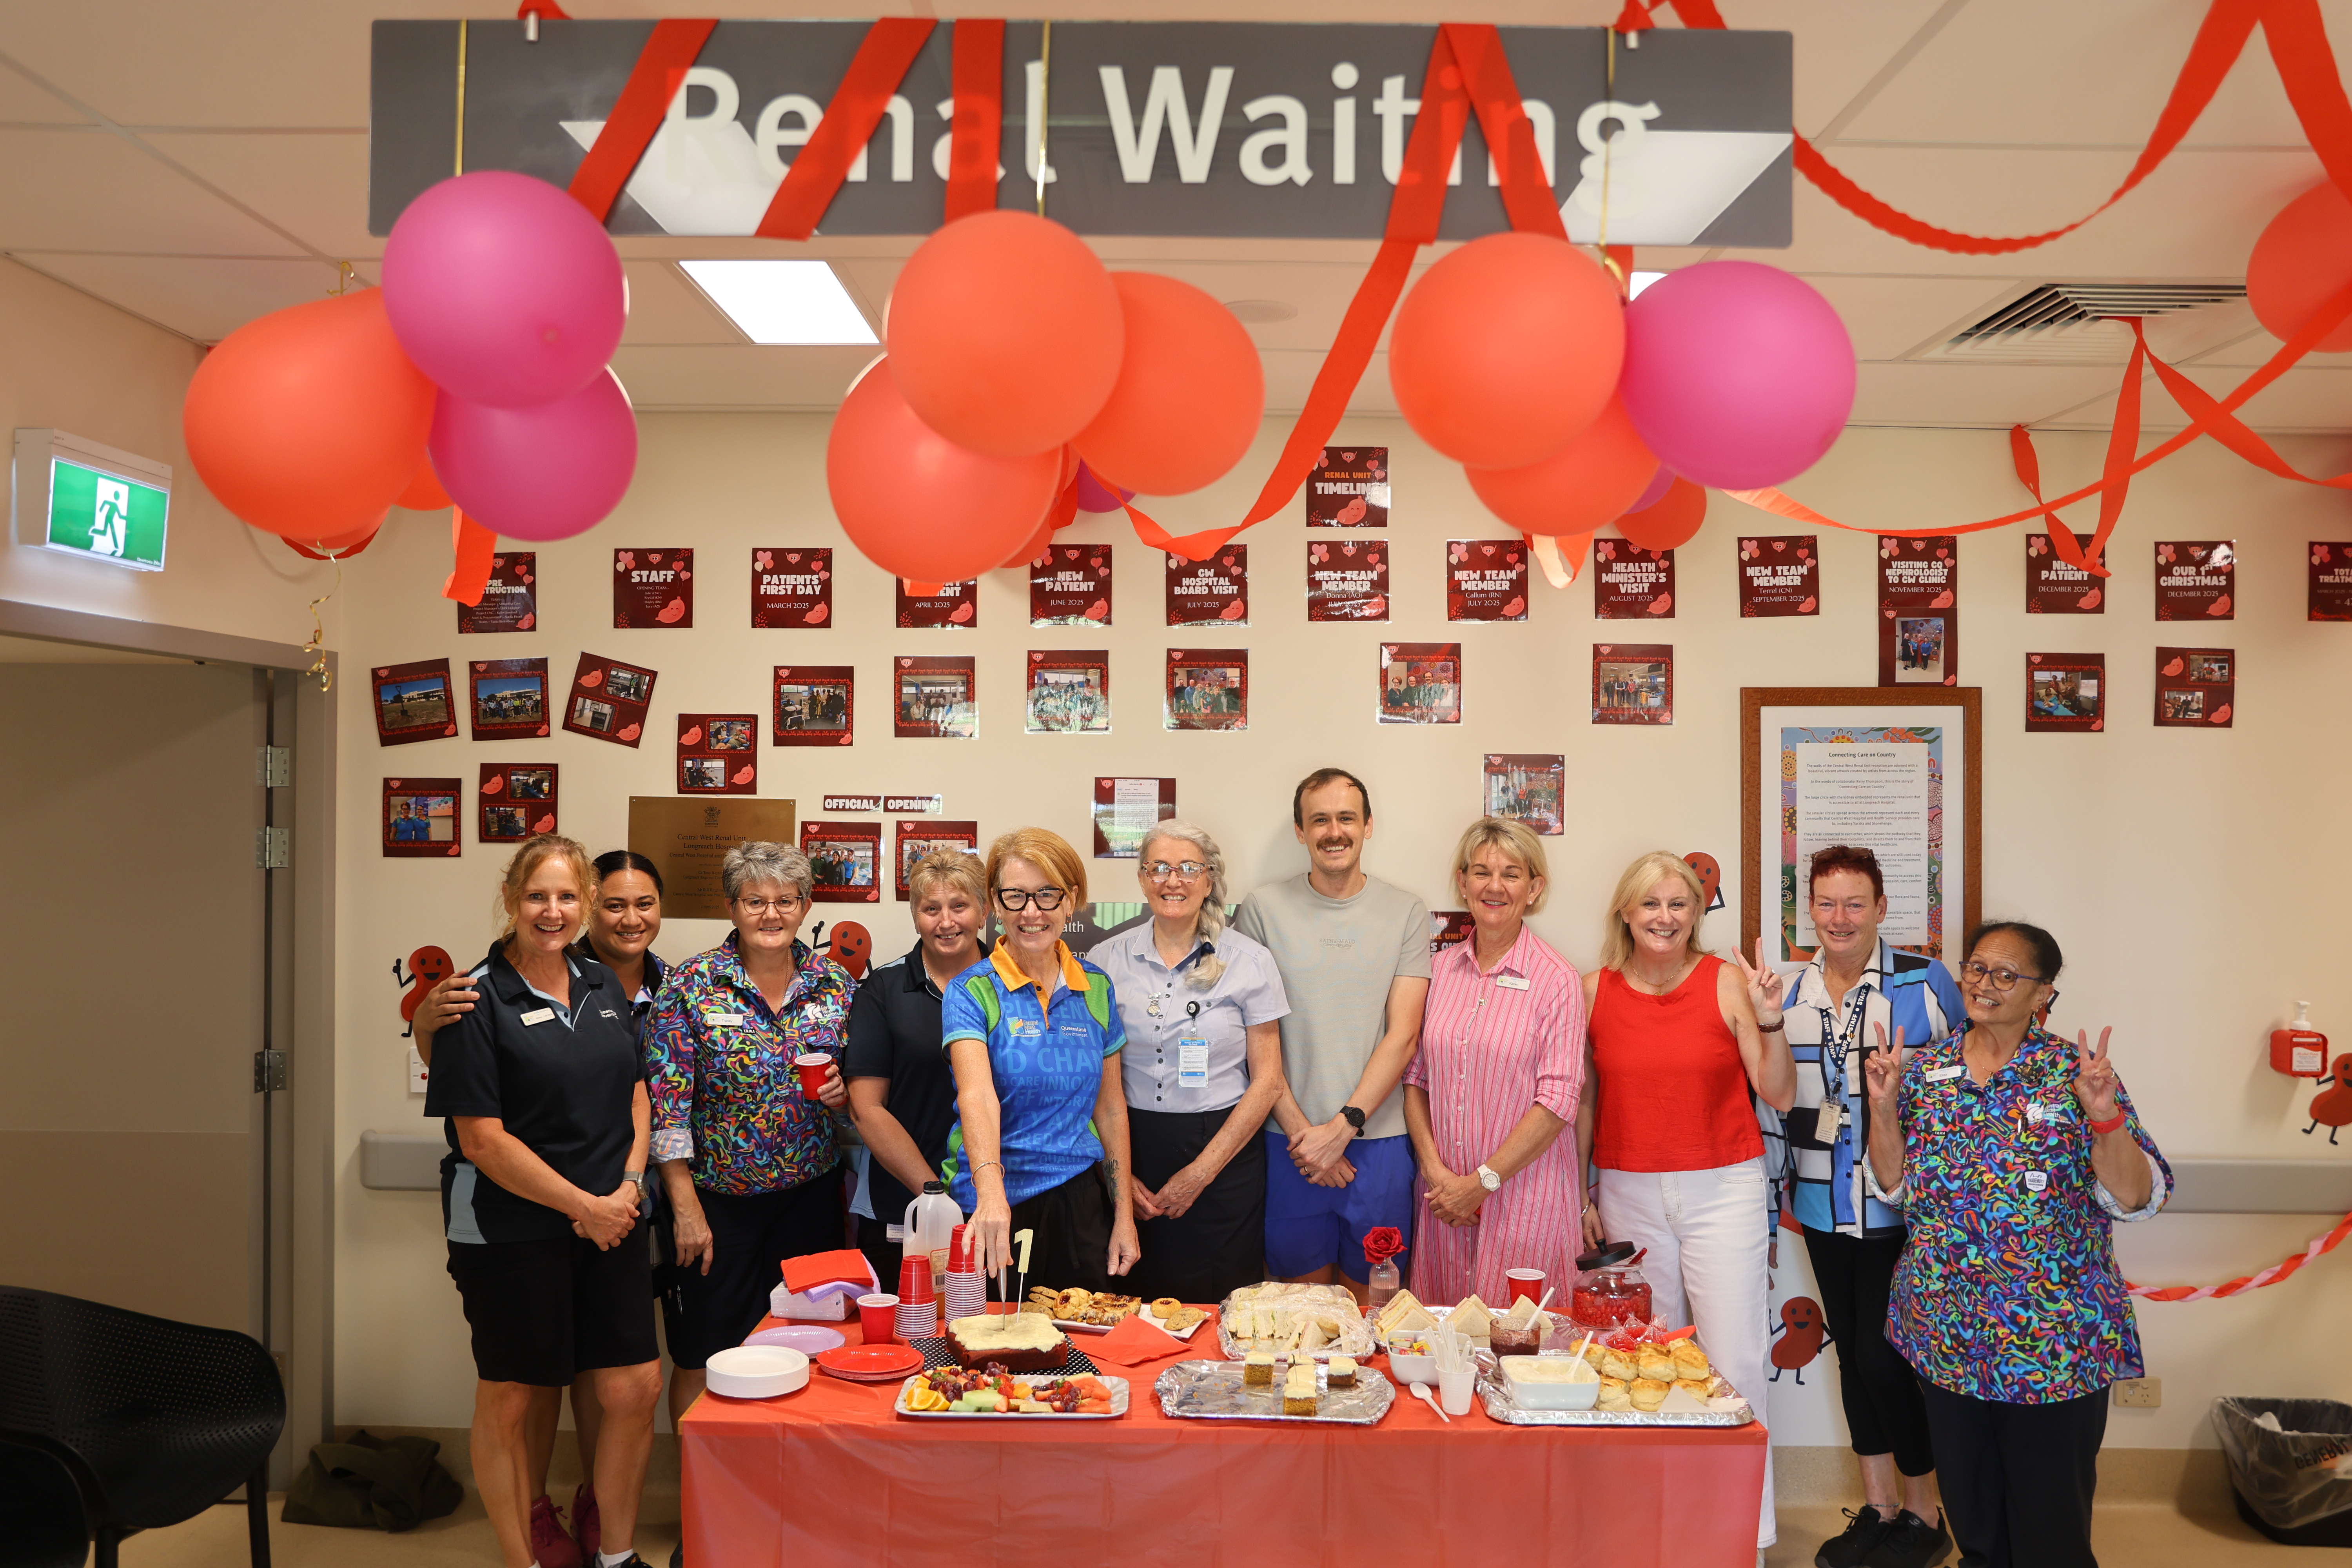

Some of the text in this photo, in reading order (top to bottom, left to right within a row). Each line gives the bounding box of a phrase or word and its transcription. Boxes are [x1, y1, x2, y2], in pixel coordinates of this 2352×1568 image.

[666, 60, 1662, 218] Renal Waiting
[1612, 562, 1655, 573] HEALTH
[1931, 561, 1943, 569] CQ
[631, 570, 675, 583] STAFF
[1056, 571, 1083, 581] NEW
[1198, 568, 1214, 577] CW
[1315, 571, 1377, 581] NEW TEAM
[1454, 570, 1517, 580] NEW TEAM
[1746, 565, 1808, 577] NEW TEAM
[1886, 568, 1948, 576] NEPHROLOGIST
[2041, 569, 2089, 581] PATIENT
[2172, 566, 2196, 576] OUR
[763, 574, 820, 585] PATIENTS
[1182, 577, 1230, 586] HOSPITAL
[1602, 572, 1666, 583] MINISTER'S
[1751, 575, 1801, 586] MEMBER
[1902, 575, 1918, 584] CW
[1918, 575, 1947, 584] CLINIC
[2160, 575, 2227, 586] CHRISTMAS
[760, 584, 822, 595] FIRST DAY
[1045, 581, 1095, 591] PATIENT
[1174, 586, 1238, 595] BOARD VISIT
[1322, 581, 1371, 591] MEMBER
[1461, 580, 1510, 590] MEMBER
[1619, 583, 1650, 593] VISIT
[824, 799, 875, 809] OFFICIAL
[887, 799, 940, 810] OPENING
[1062, 921, 1084, 932] alth
[1857, 988, 1867, 1005] STAFF
[1823, 1017, 1831, 1033] STAFF
[1849, 1014, 1858, 1031] STAFF
[1828, 1041, 1837, 1059] STAFF
[1839, 1039, 1849, 1058] STAFF
[1037, 1047, 1103, 1073] CHAN
[1010, 1076, 1040, 1087] CARE
[2018, 1074, 2029, 1083] ELIZA
[1042, 1076, 1101, 1093] INNOVA
[1014, 1228, 1033, 1273] 1
